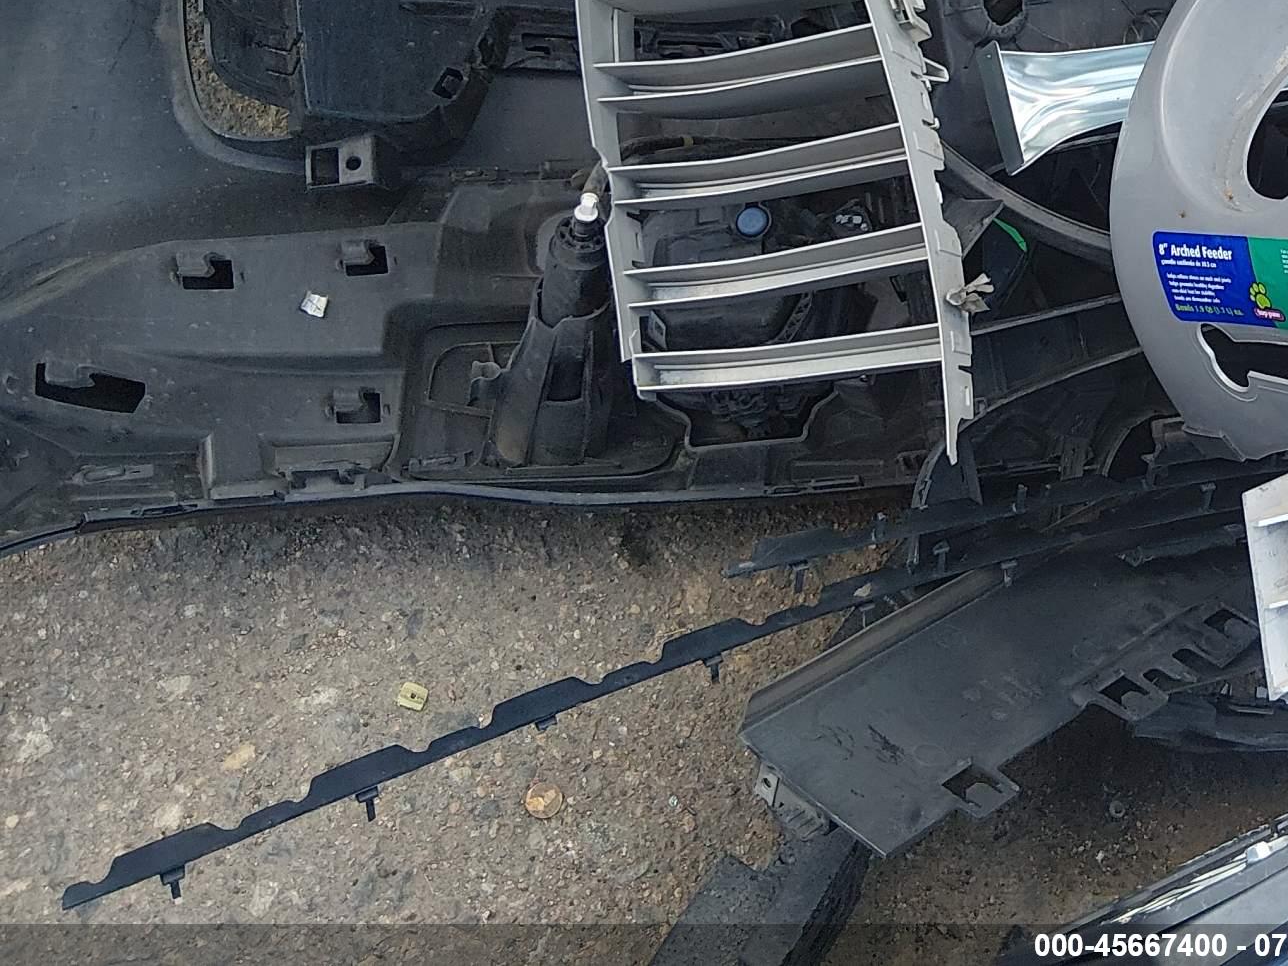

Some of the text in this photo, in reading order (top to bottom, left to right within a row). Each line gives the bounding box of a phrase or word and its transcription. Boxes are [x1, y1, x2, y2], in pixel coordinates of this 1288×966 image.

[1159, 243, 1232, 260] 8" Arched Feeder
